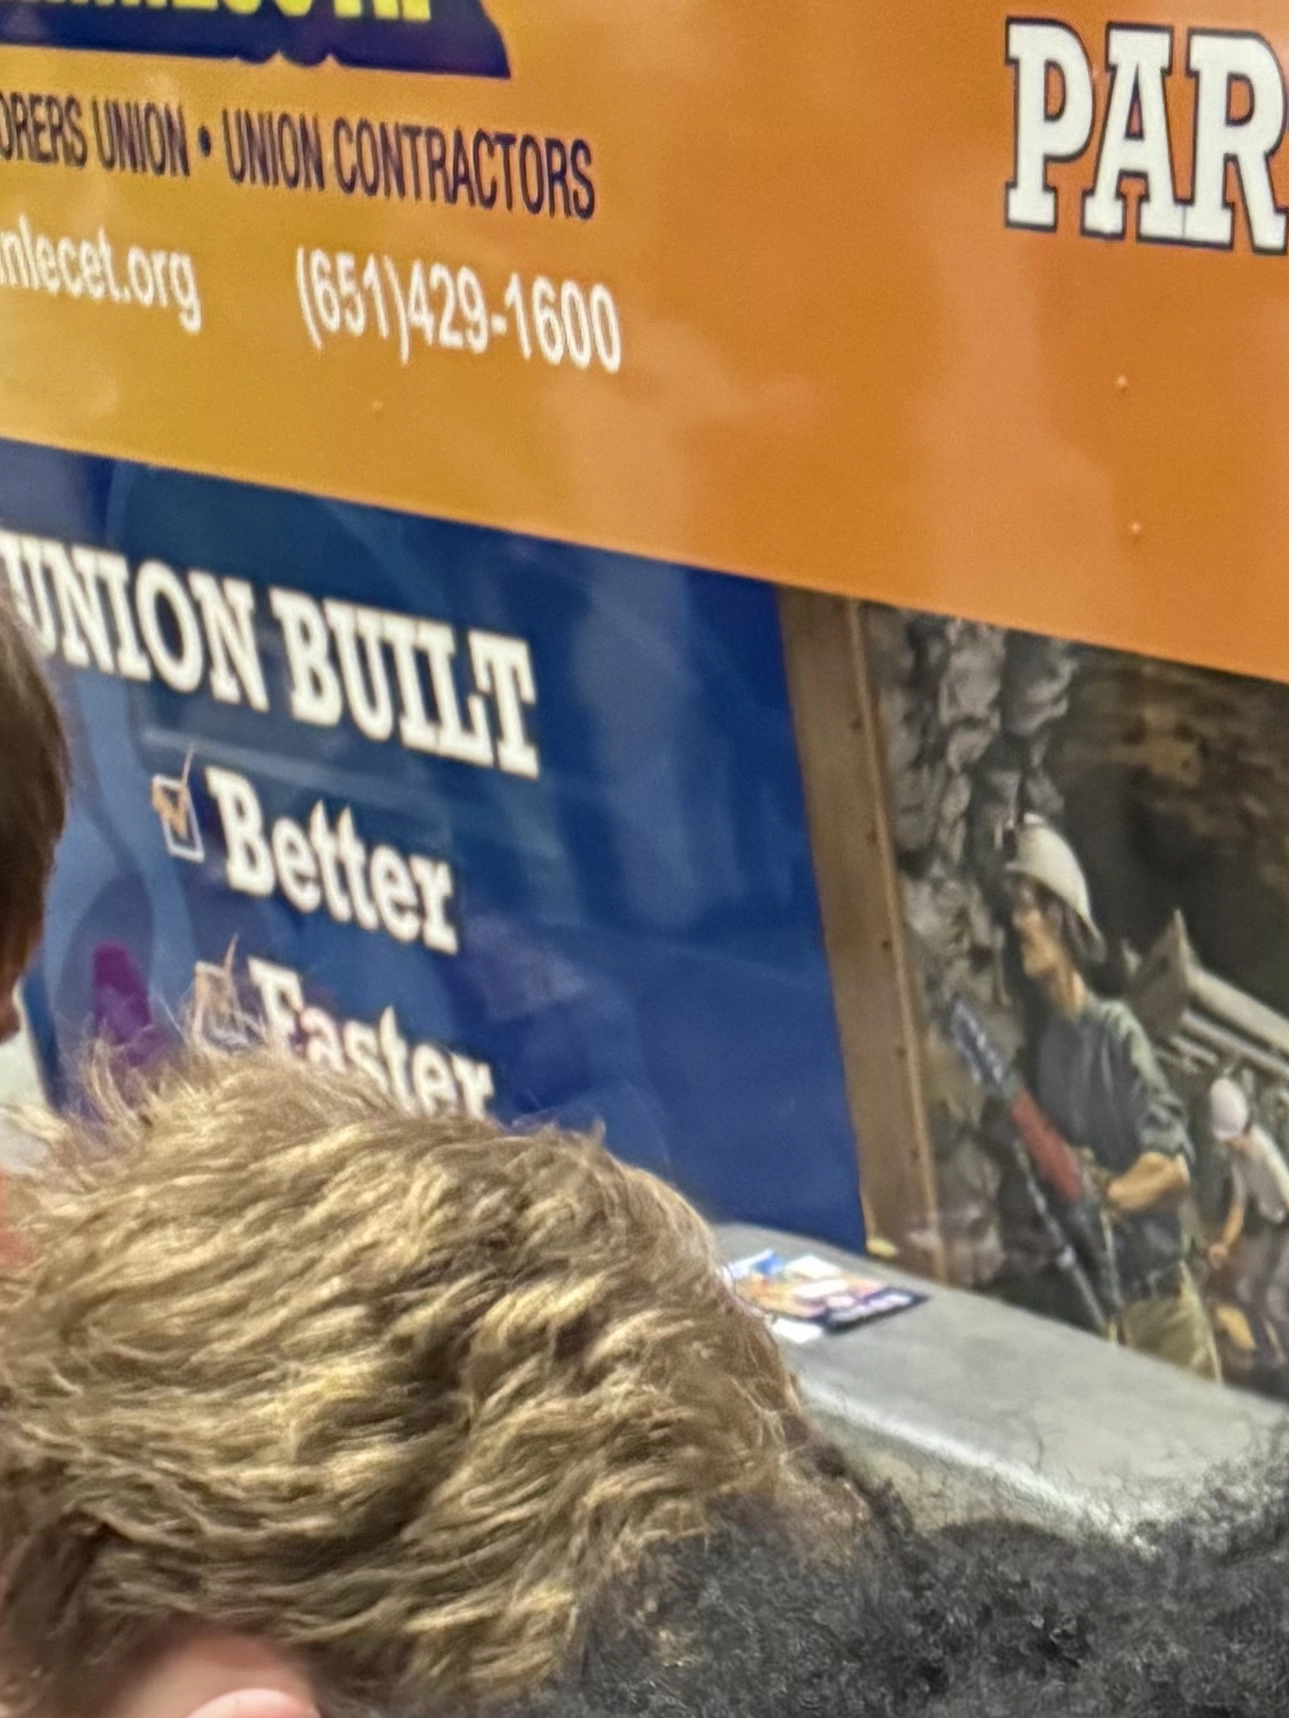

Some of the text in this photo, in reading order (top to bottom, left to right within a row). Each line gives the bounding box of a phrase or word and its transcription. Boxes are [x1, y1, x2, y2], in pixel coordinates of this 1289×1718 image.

[91, 95, 190, 178] UNION
[222, 107, 326, 192] UNION
[332, 115, 596, 221] CONTRACTORS
[0, 214, 622, 373] nlecet.org (651)429-1600
[0, 529, 540, 778] UNION BUILT
[206, 765, 458, 955] Better
[247, 955, 494, 1120] Faster
